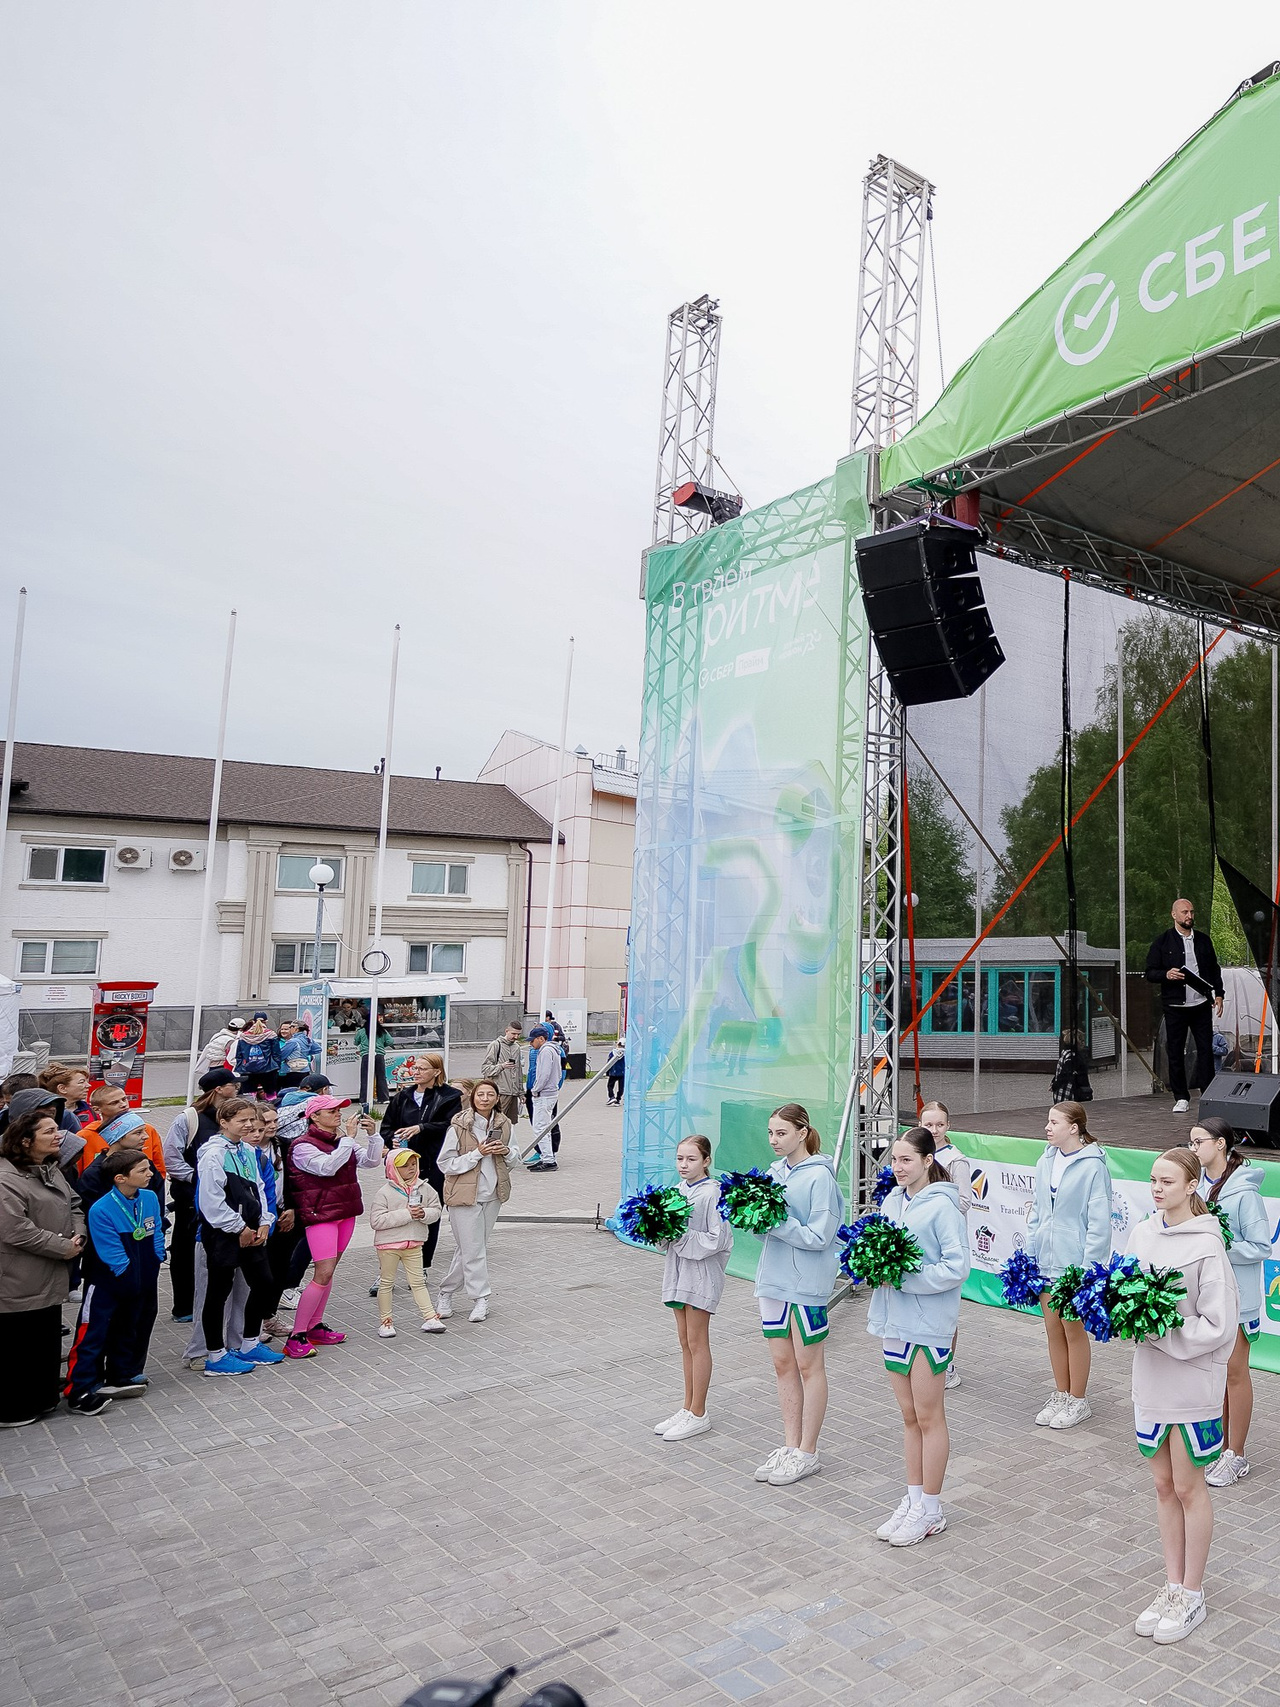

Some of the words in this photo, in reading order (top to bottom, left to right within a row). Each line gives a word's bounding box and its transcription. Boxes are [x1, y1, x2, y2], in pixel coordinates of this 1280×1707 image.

[672, 581, 686, 614] В
[710, 662, 734, 682] СБЕР
[1000, 1204, 1025, 1216] Fratelli
